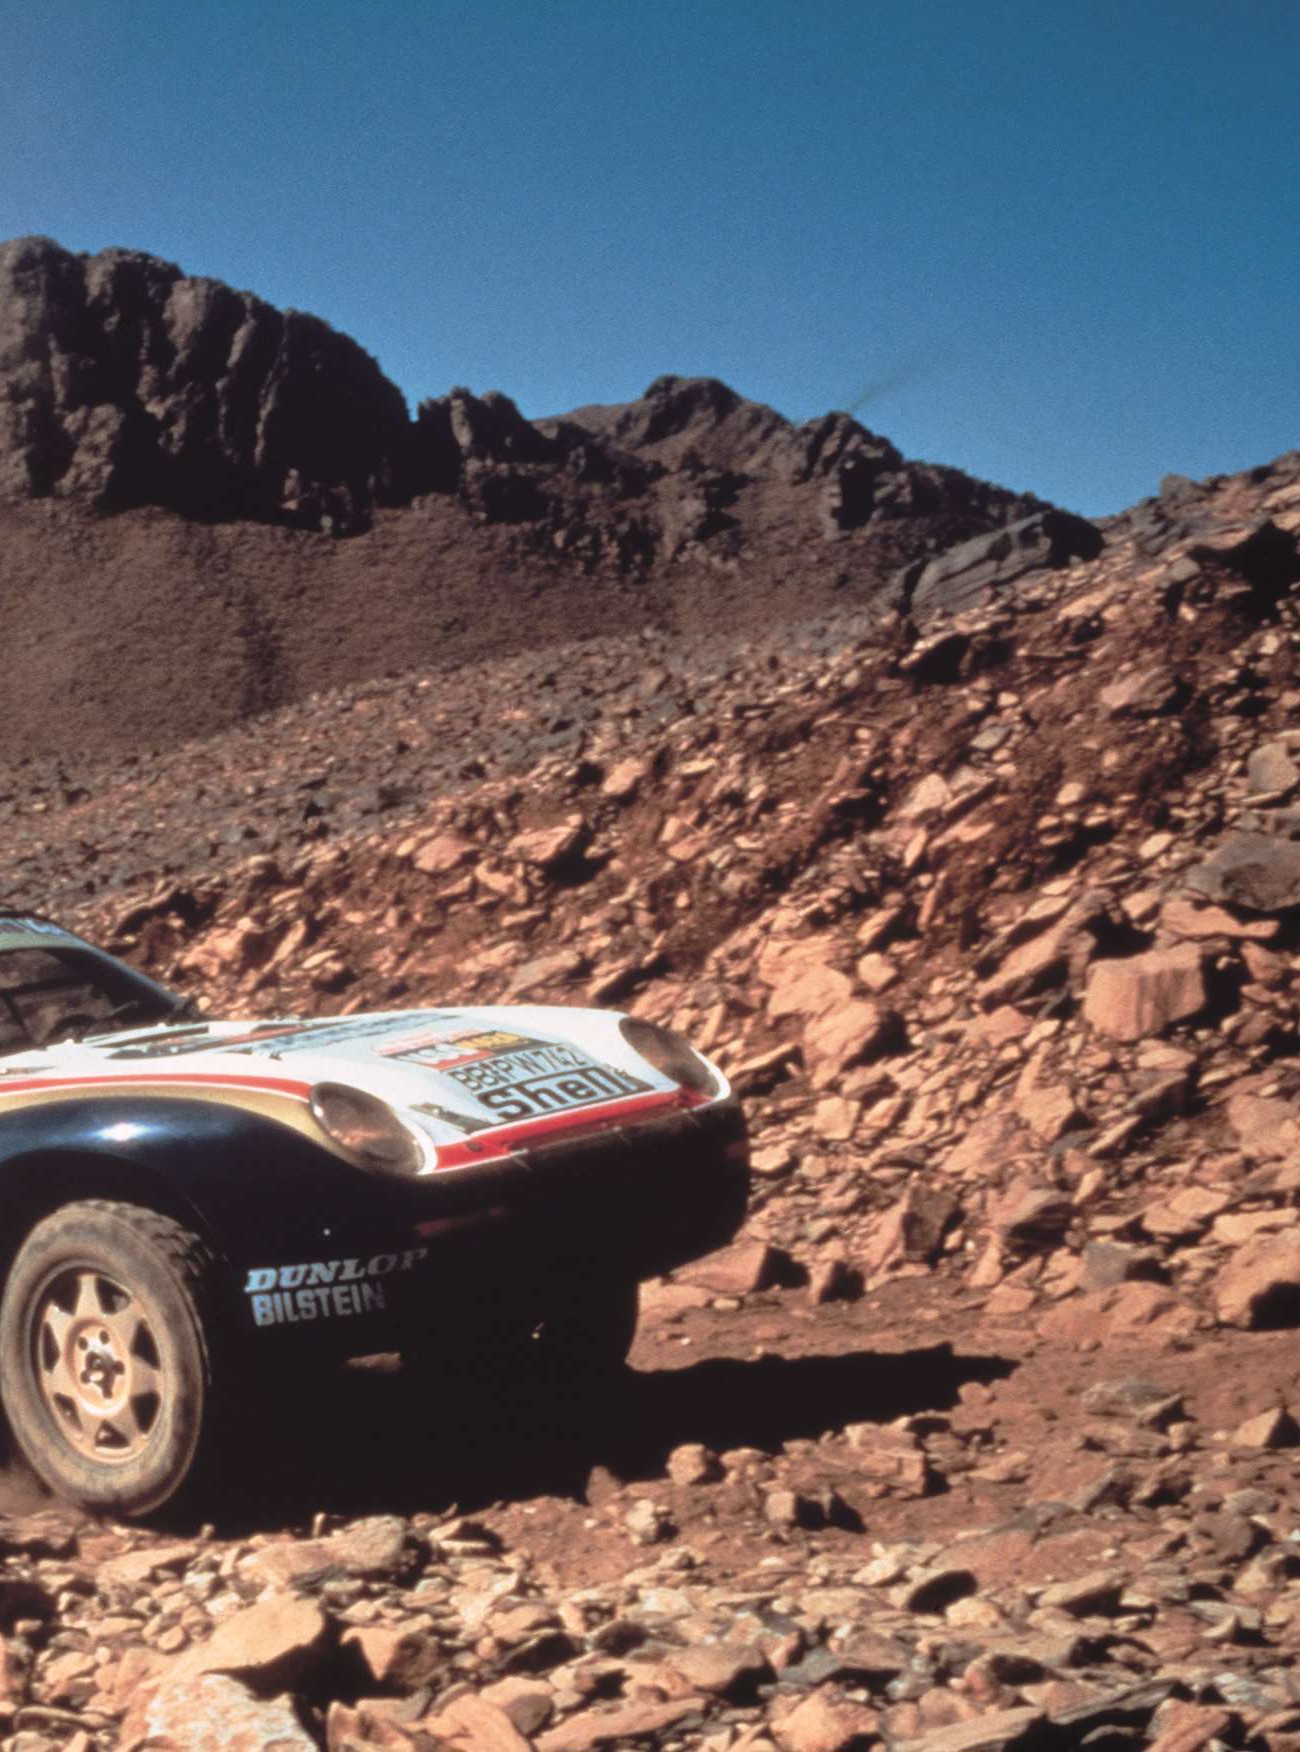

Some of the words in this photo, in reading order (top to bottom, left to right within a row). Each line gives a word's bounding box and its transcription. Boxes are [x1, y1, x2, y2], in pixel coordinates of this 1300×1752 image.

[476, 1066, 640, 1122] Shell
[244, 1248, 428, 1293] DUNLOP
[252, 1282, 386, 1326] BILSTEIN
